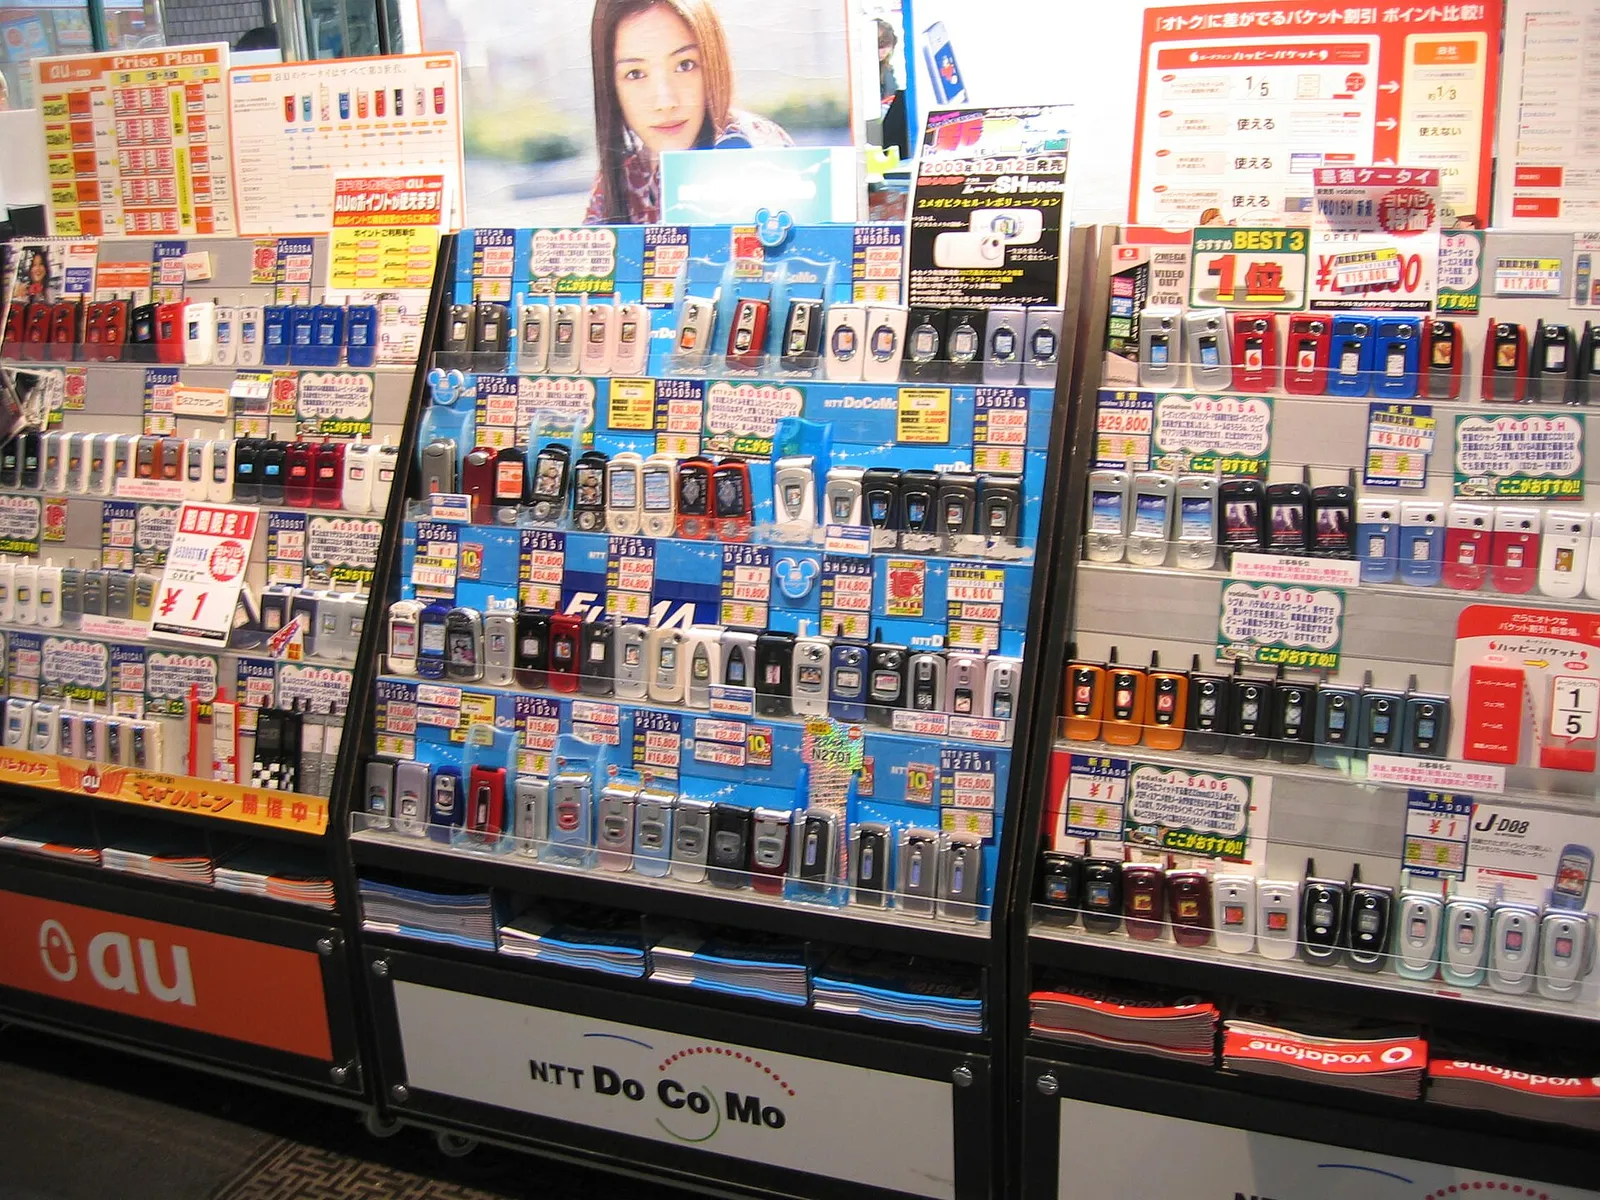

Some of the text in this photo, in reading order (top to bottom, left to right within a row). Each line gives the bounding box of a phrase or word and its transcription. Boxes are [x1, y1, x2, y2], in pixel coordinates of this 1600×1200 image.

[112, 52, 205, 69] Prise Plan
[1237, 118, 1275, 130] 使える
[1235, 157, 1273, 169] 使える
[1319, 168, 1431, 184] 最強ケータイ
[1232, 195, 1270, 207] 使える
[1233, 231, 1286, 250] BEST
[1290, 232, 1305, 250] 3
[1154, 270, 1184, 279] VIDEO
[1208, 254, 1286, 301] 1位
[942, 758, 991, 771] N2701
[82, 775, 101, 788] au
[1474, 813, 1529, 834] J-D08
[87, 931, 197, 1006] au
[1249, 1041, 1372, 1065] vodafone
[529, 1059, 585, 1090] NTT
